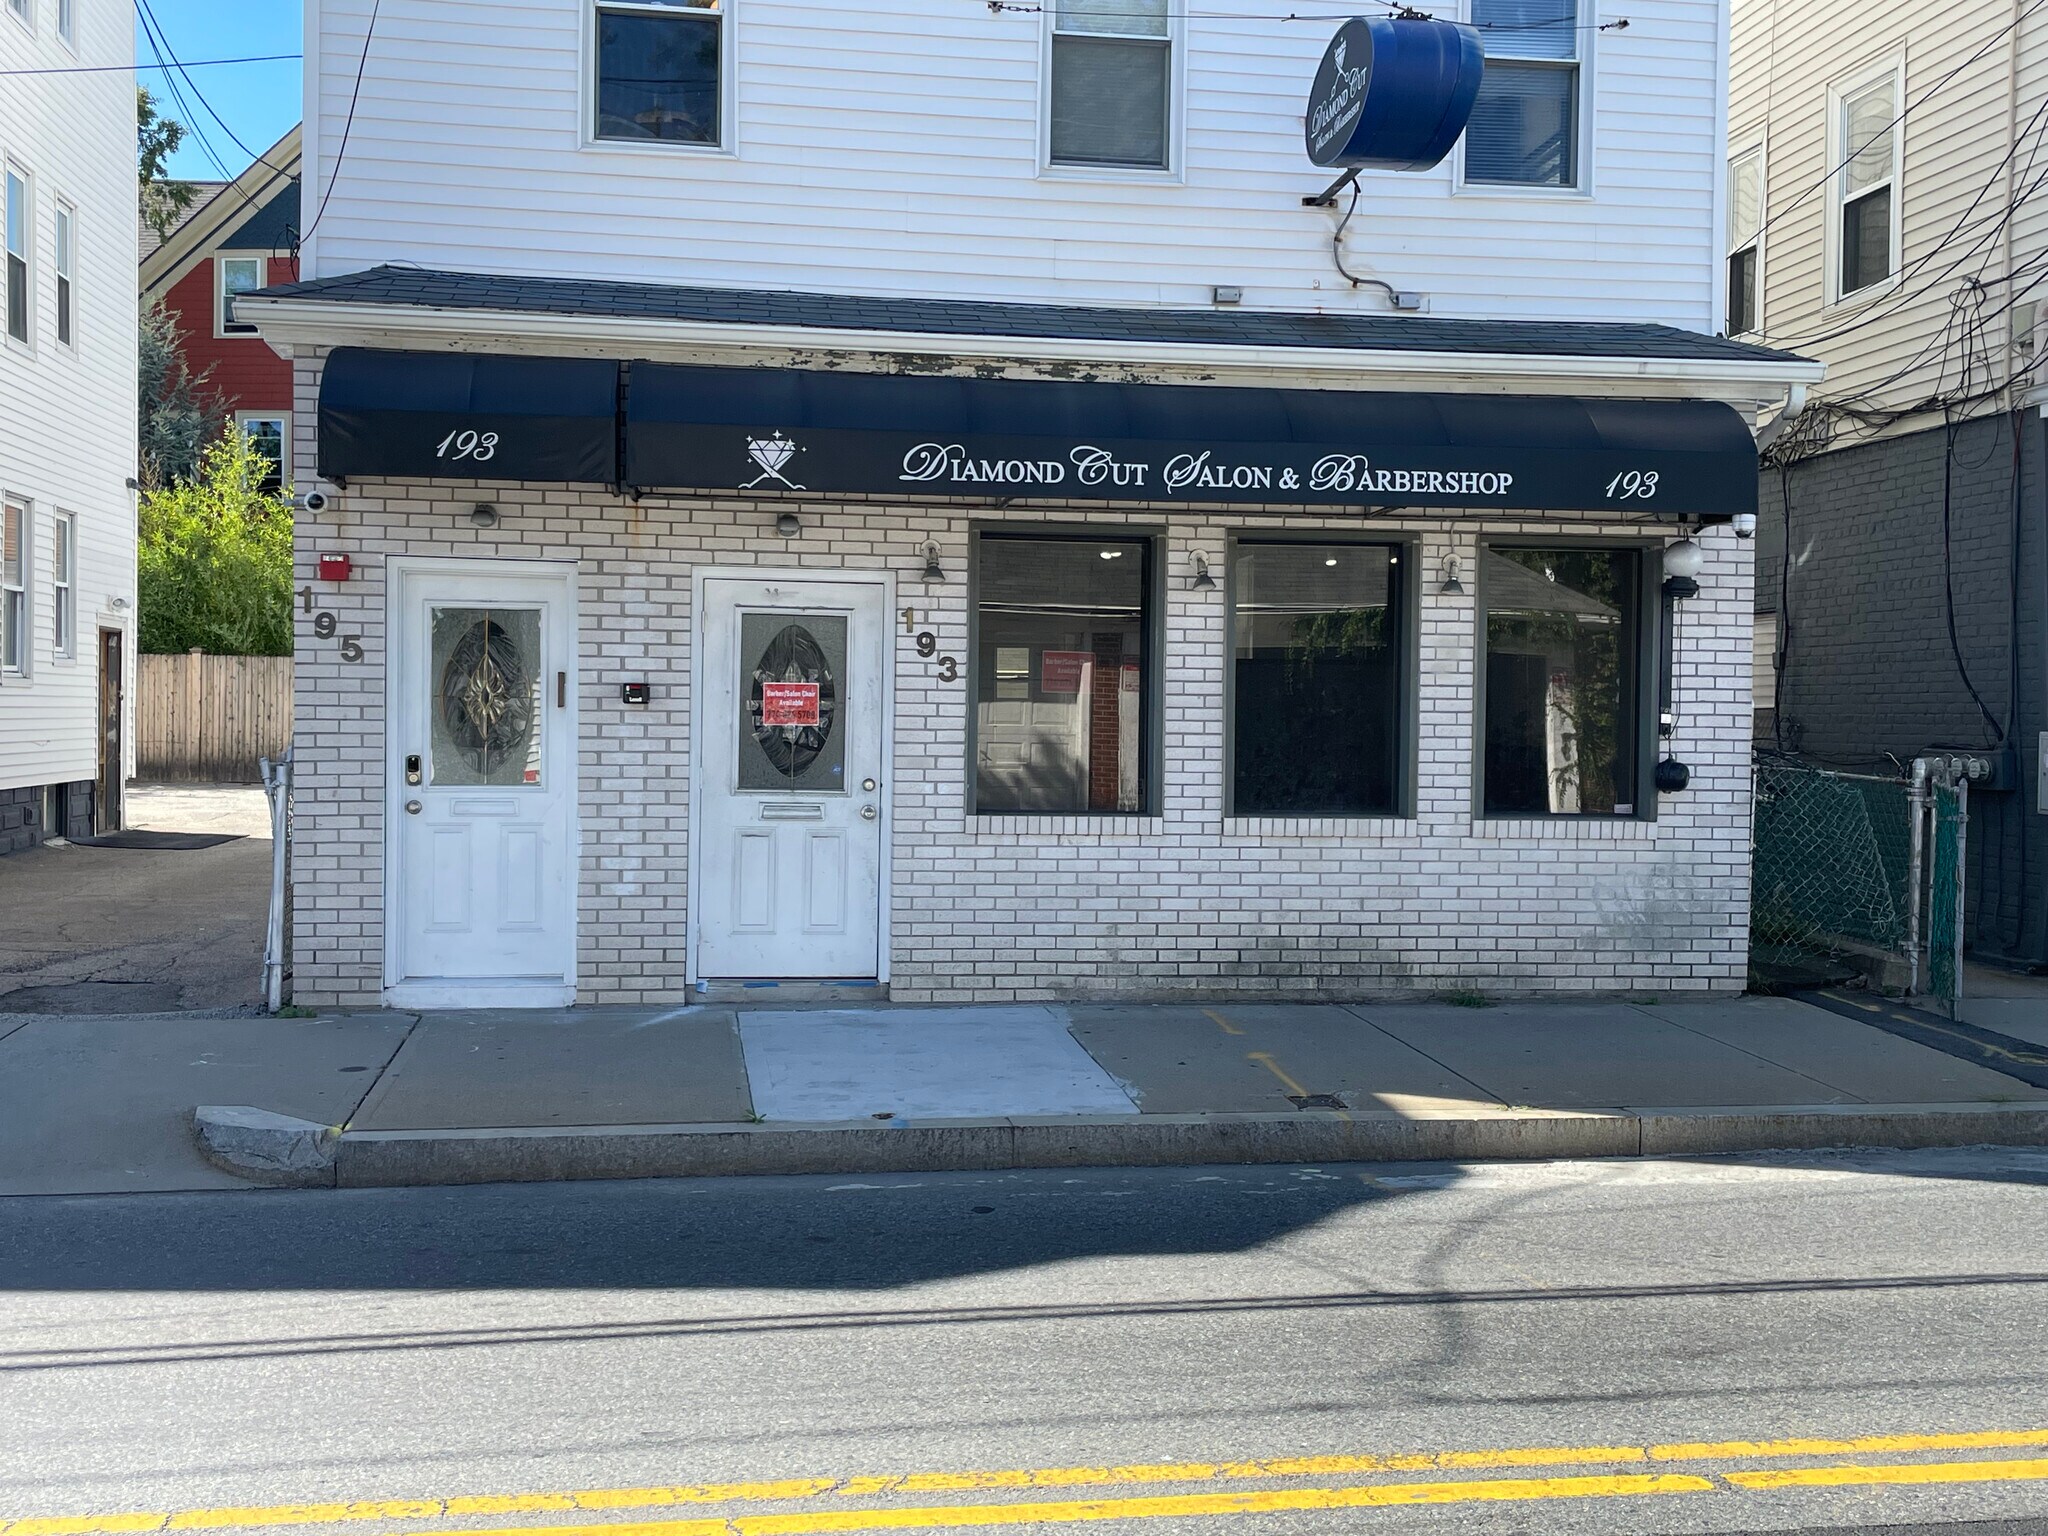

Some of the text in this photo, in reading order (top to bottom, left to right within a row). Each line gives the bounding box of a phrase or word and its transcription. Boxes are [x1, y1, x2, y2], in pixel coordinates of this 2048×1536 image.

[1311, 66, 1367, 138] DIAMOND CUT
[436, 430, 499, 461] 193
[899, 443, 1513, 494] DIAMOND CUT SALON & BARBERSHOP
[1605, 470, 1660, 500] 193
[298, 586, 363, 662] 195
[901, 606, 958, 683] 193
[766, 689, 801, 698] Barber/Salon
